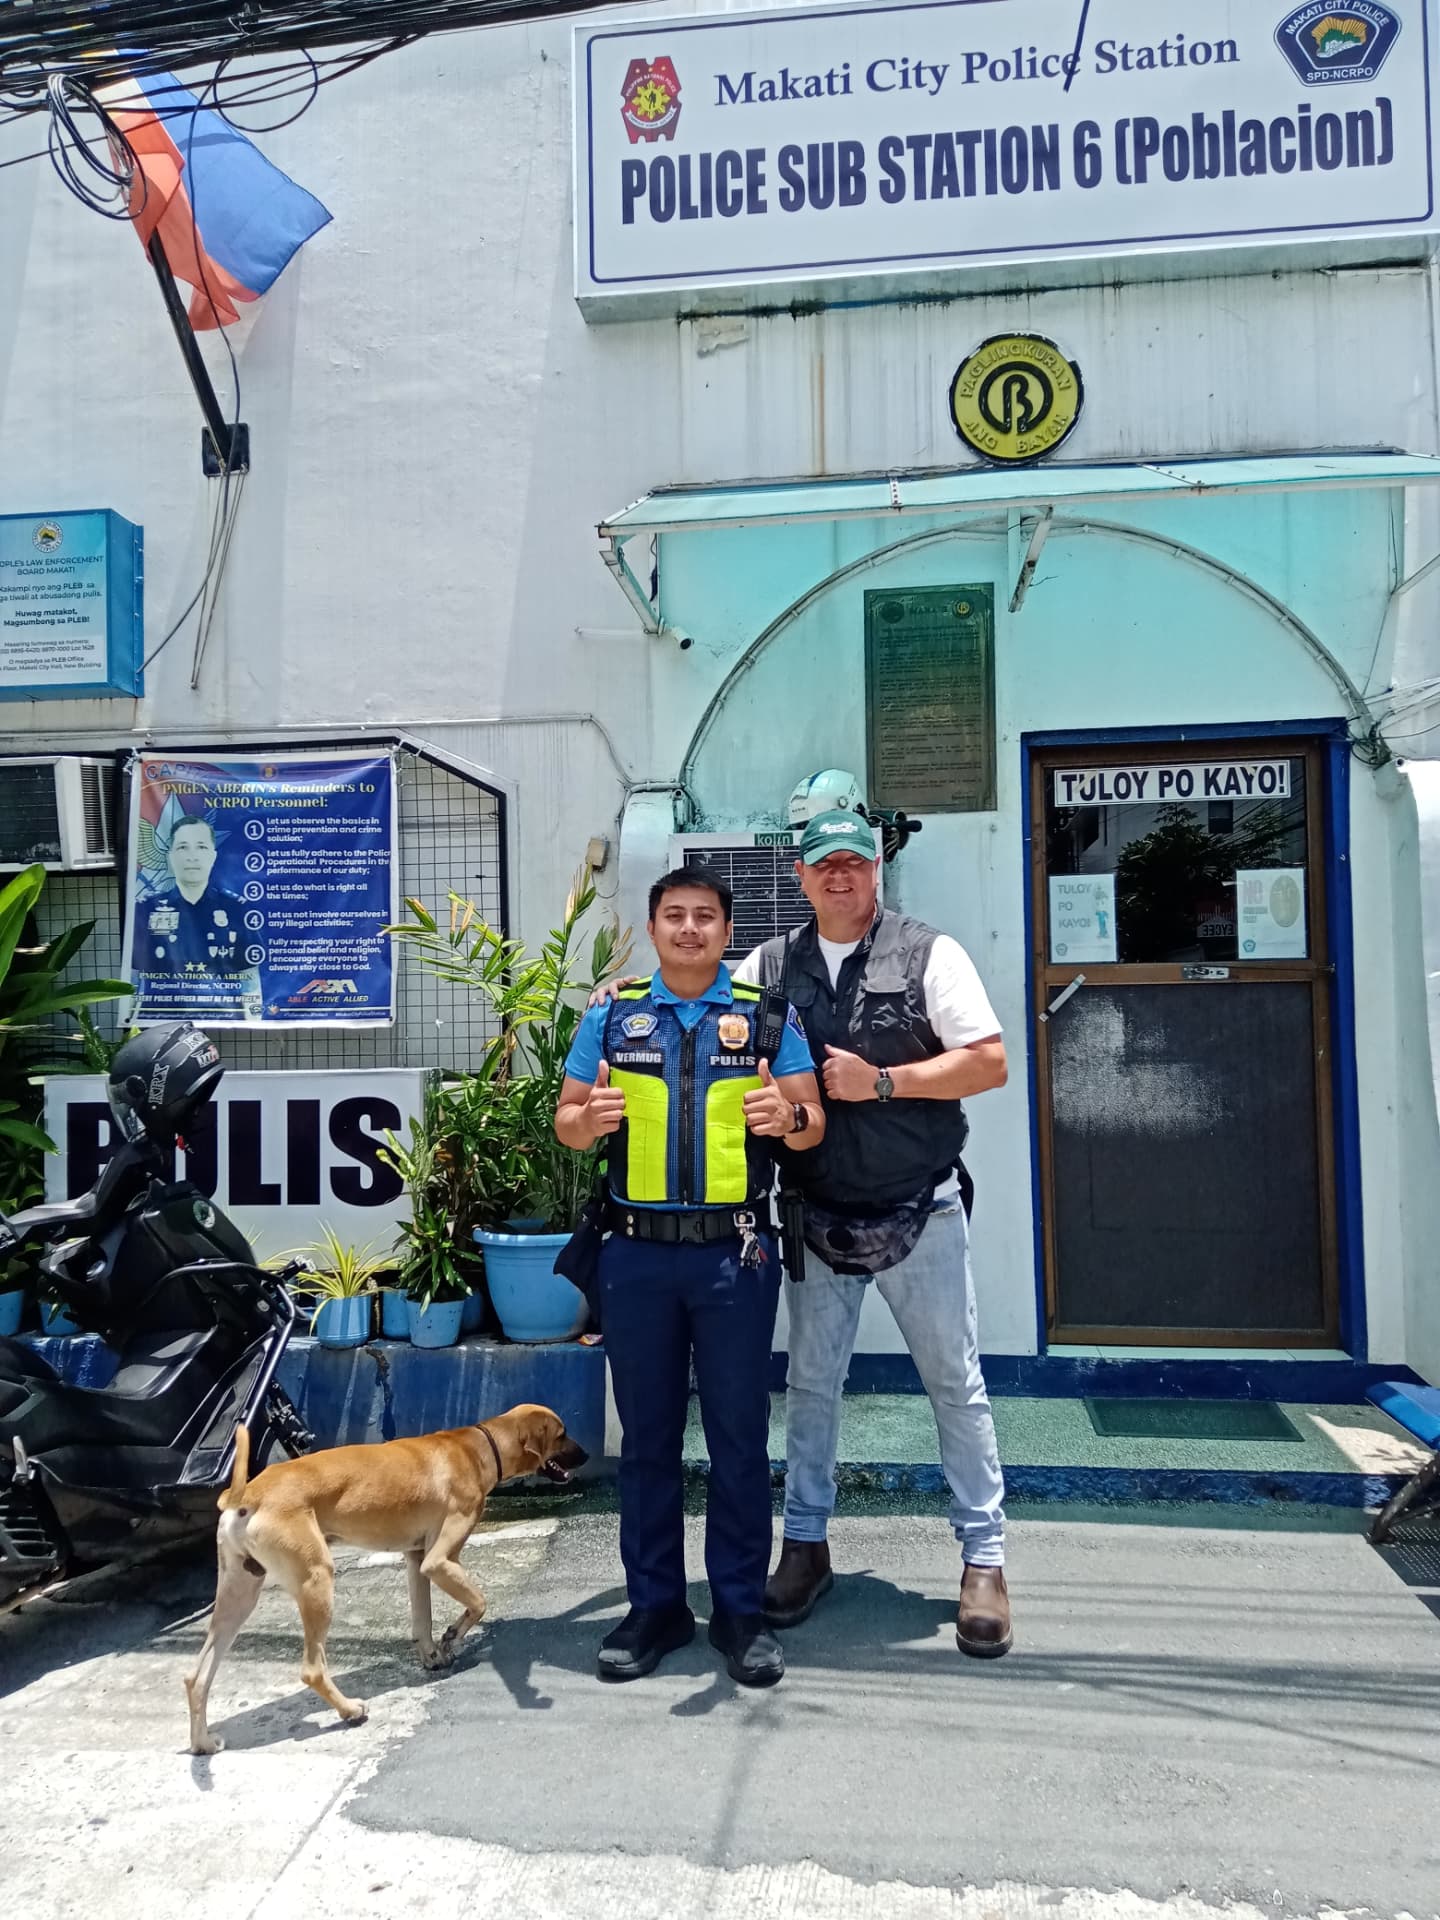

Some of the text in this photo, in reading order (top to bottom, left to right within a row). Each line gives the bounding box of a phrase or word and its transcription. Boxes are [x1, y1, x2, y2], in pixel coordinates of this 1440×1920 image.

[1285, 0, 1390, 35] MAKATI CITY POLICE
[714, 33, 1241, 106] Makati City Police Station
[1307, 67, 1374, 81] SPD-NCRPO
[621, 96, 1394, 225] POLICE SUB STATION 6 (Poblacion)
[964, 414, 1069, 454] ANG BAYAN
[45, 556, 104, 566] ENFORCEMENT
[4, 618, 55, 627] Magsumbong
[163, 783, 209, 794] PMGEN
[280, 782, 356, 793] Reminders
[360, 781, 375, 793] to
[1060, 764, 1286, 802] TULOY PO KAYO!
[203, 796, 328, 809] NCRPO Personnel:
[291, 817, 325, 825] observe
[326, 817, 341, 825] the
[250, 825, 258, 836] 1
[757, 833, 791, 846] koin
[250, 857, 259, 868] 2
[249, 885, 259, 897] 3
[1057, 883, 1092, 895] TULOY
[1058, 901, 1073, 911] PO
[250, 916, 259, 927] 4
[250, 949, 260, 961] 5
[311, 995, 340, 1003] ACTIVE
[343, 995, 369, 1003] ALLIED
[710, 1055, 756, 1066] PULIS
